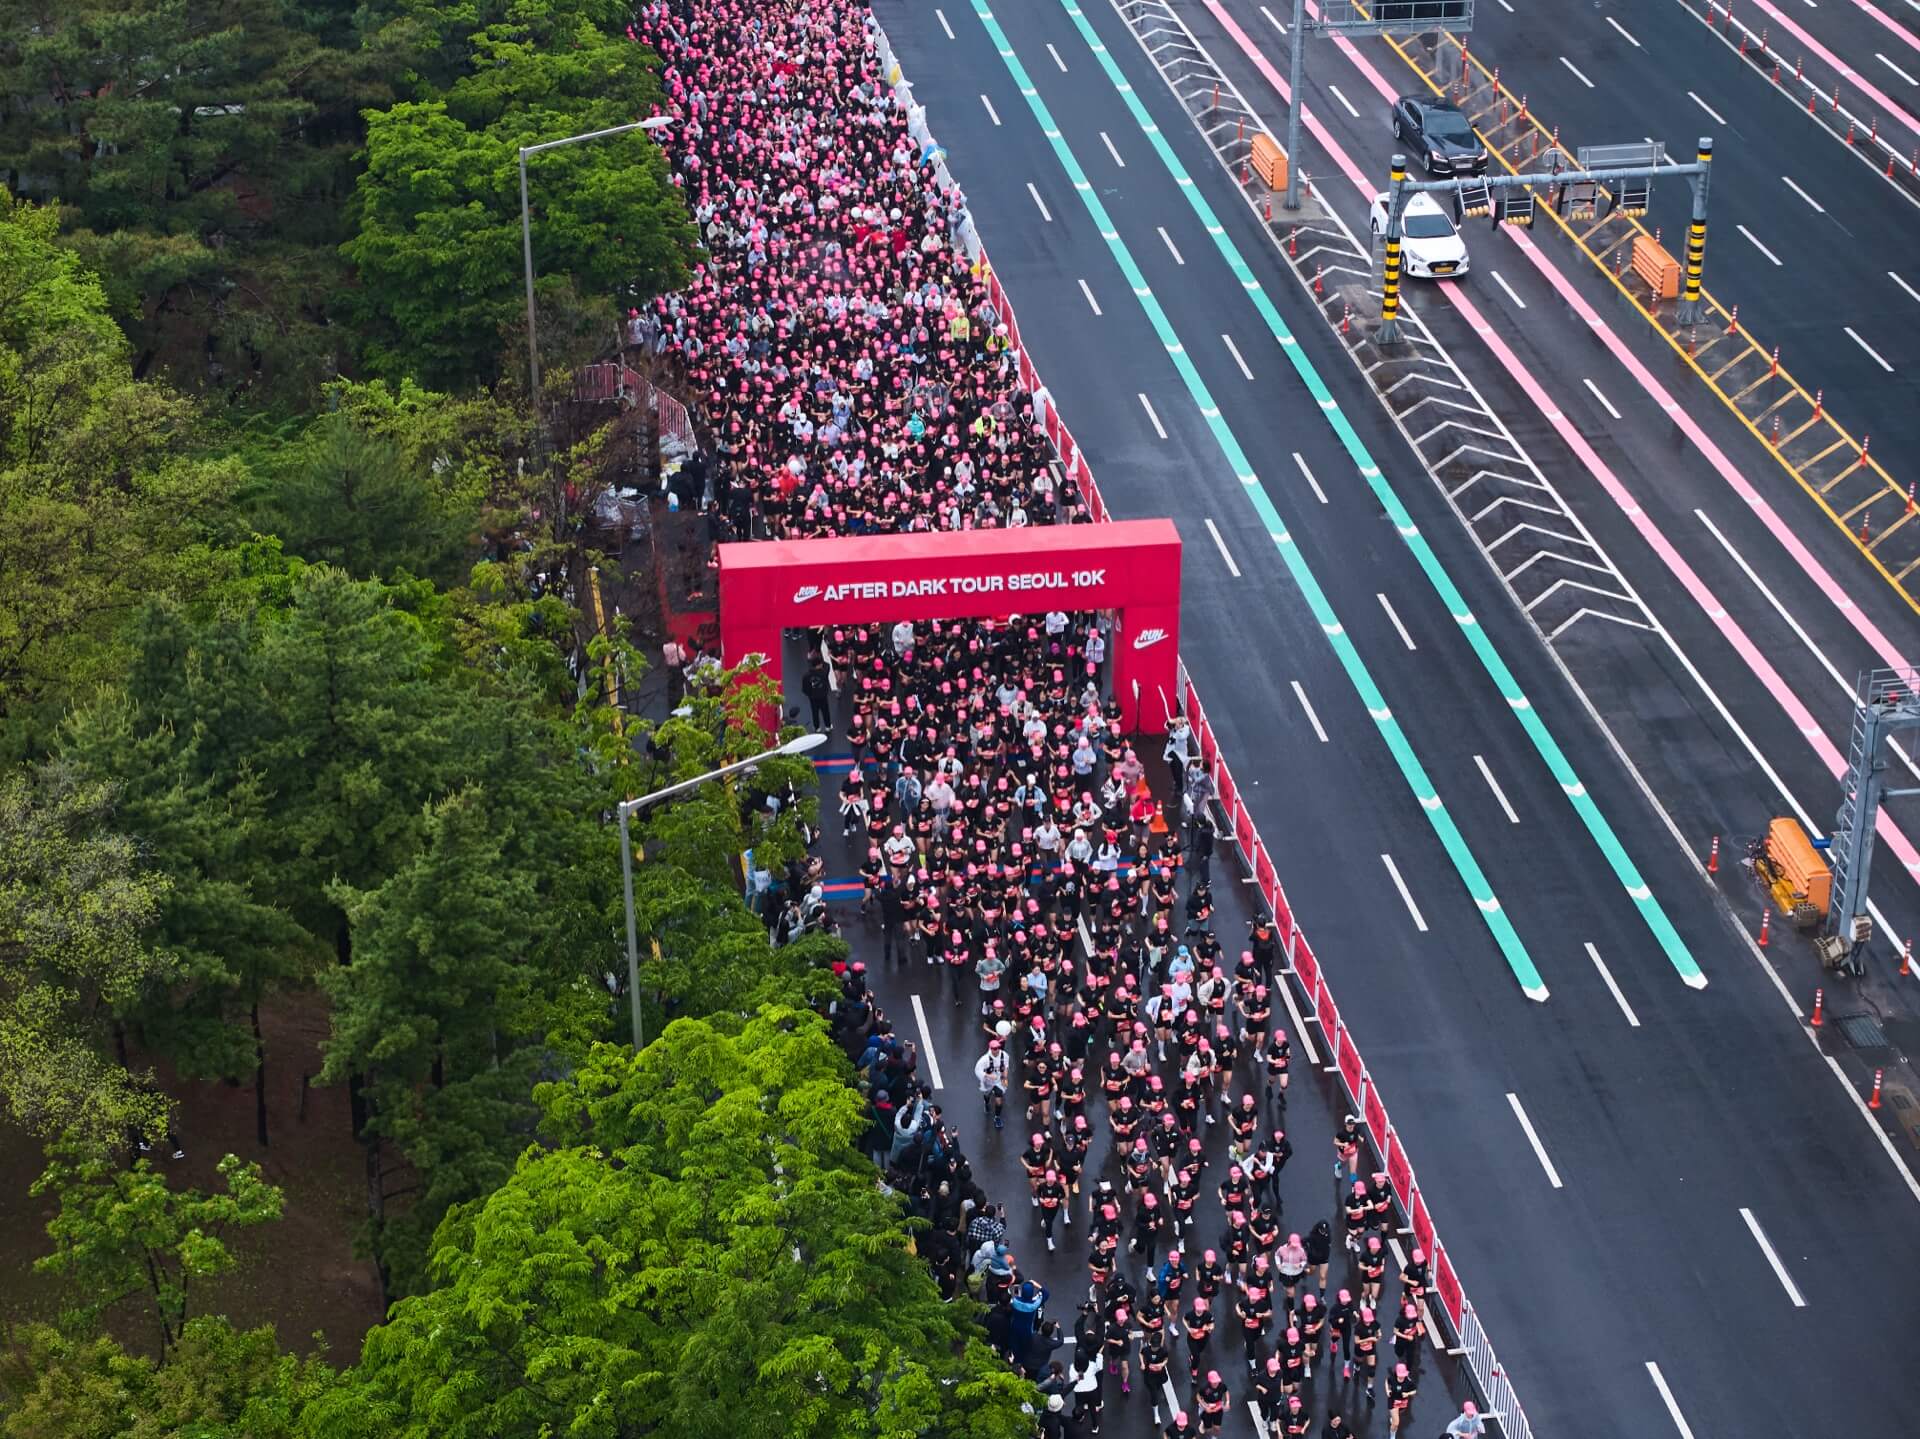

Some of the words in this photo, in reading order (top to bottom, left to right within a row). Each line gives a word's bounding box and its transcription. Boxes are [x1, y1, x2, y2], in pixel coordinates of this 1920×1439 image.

[824, 582, 888, 601] AFTER
[892, 578, 947, 597] DARK
[950, 575, 1004, 594] TOUR
[1007, 572, 1068, 590] SEOUL
[1071, 569, 1106, 587] 10K
[1140, 628, 1164, 641] RUN
